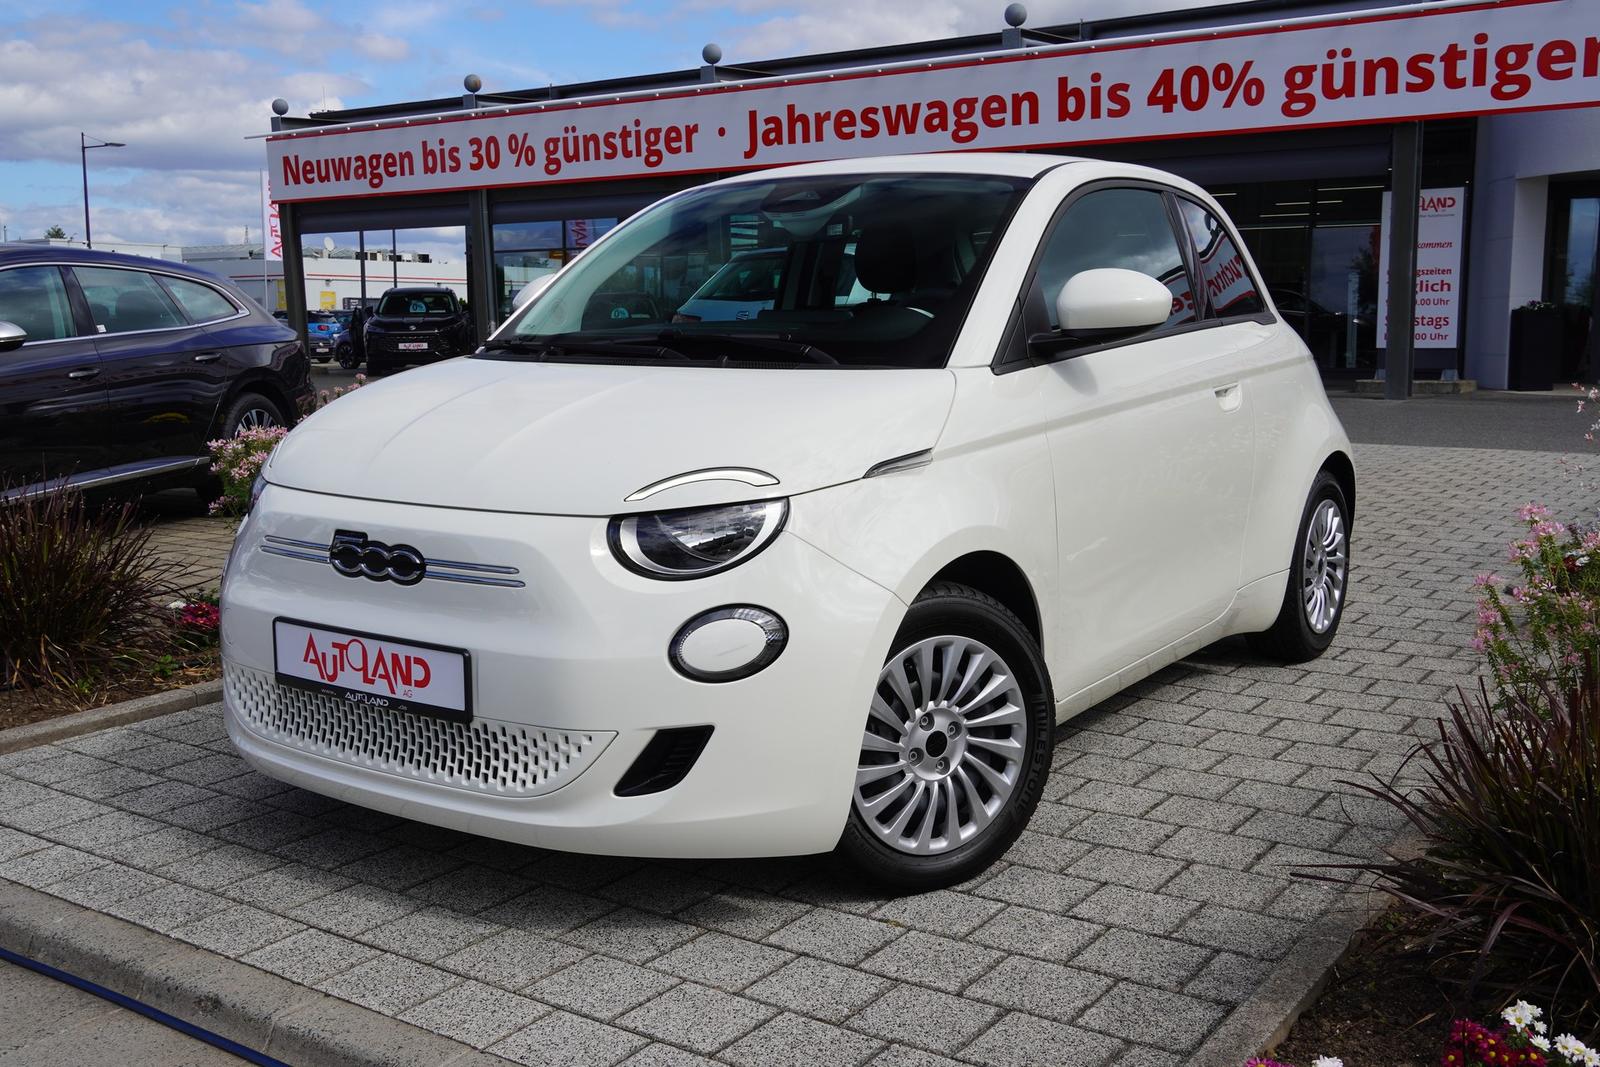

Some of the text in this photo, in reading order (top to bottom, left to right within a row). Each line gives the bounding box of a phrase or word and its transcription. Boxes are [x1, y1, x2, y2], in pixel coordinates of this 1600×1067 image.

[282, 32, 1600, 188] Neuwagen bis 30 % günstiger Jahreswagen bis 40% günstiger
[1419, 196, 1456, 212] LAND
[1416, 241, 1452, 249] kommen
[1416, 267, 1452, 277] gszeiten
[1416, 280, 1452, 294] lich
[1433, 298, 1450, 306] Uhr
[1414, 315, 1450, 329] stags
[1430, 333, 1449, 341] Uhr
[329, 529, 427, 586] 500
[402, 689, 413, 698] AG
